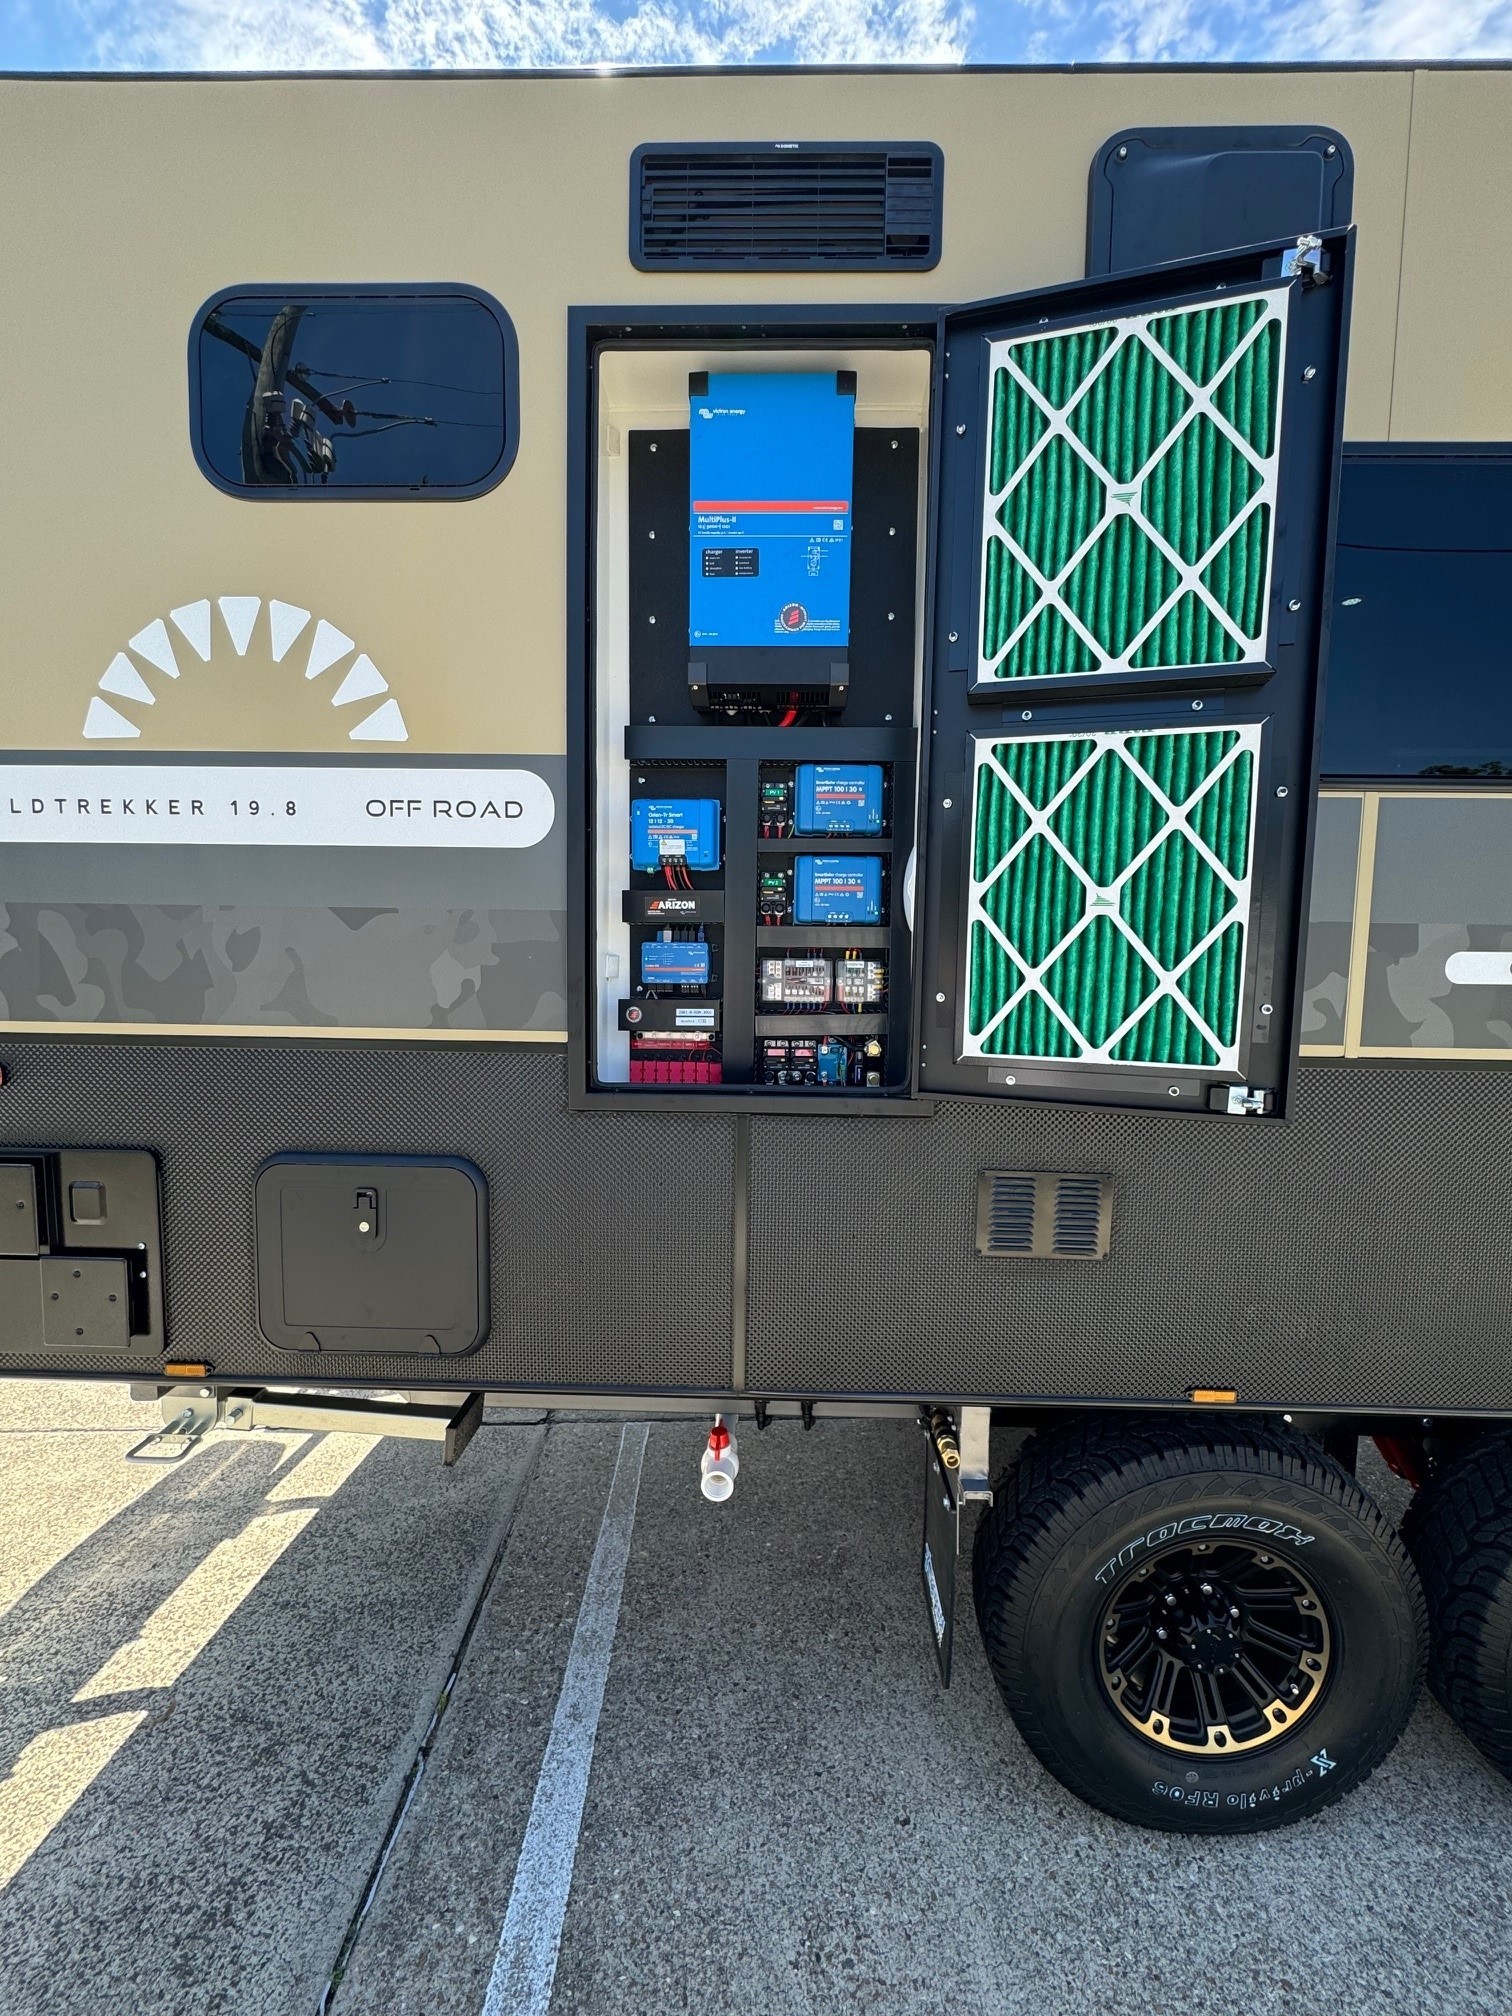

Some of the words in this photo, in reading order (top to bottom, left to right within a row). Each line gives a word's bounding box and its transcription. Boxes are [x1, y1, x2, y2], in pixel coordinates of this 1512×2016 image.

[697, 515, 737, 523] MultiPlus-II
[230, 799, 297, 817] 19.8
[365, 799, 422, 818] OFF
[433, 799, 524, 819] ROAD
[658, 900, 696, 910] ARIZON
